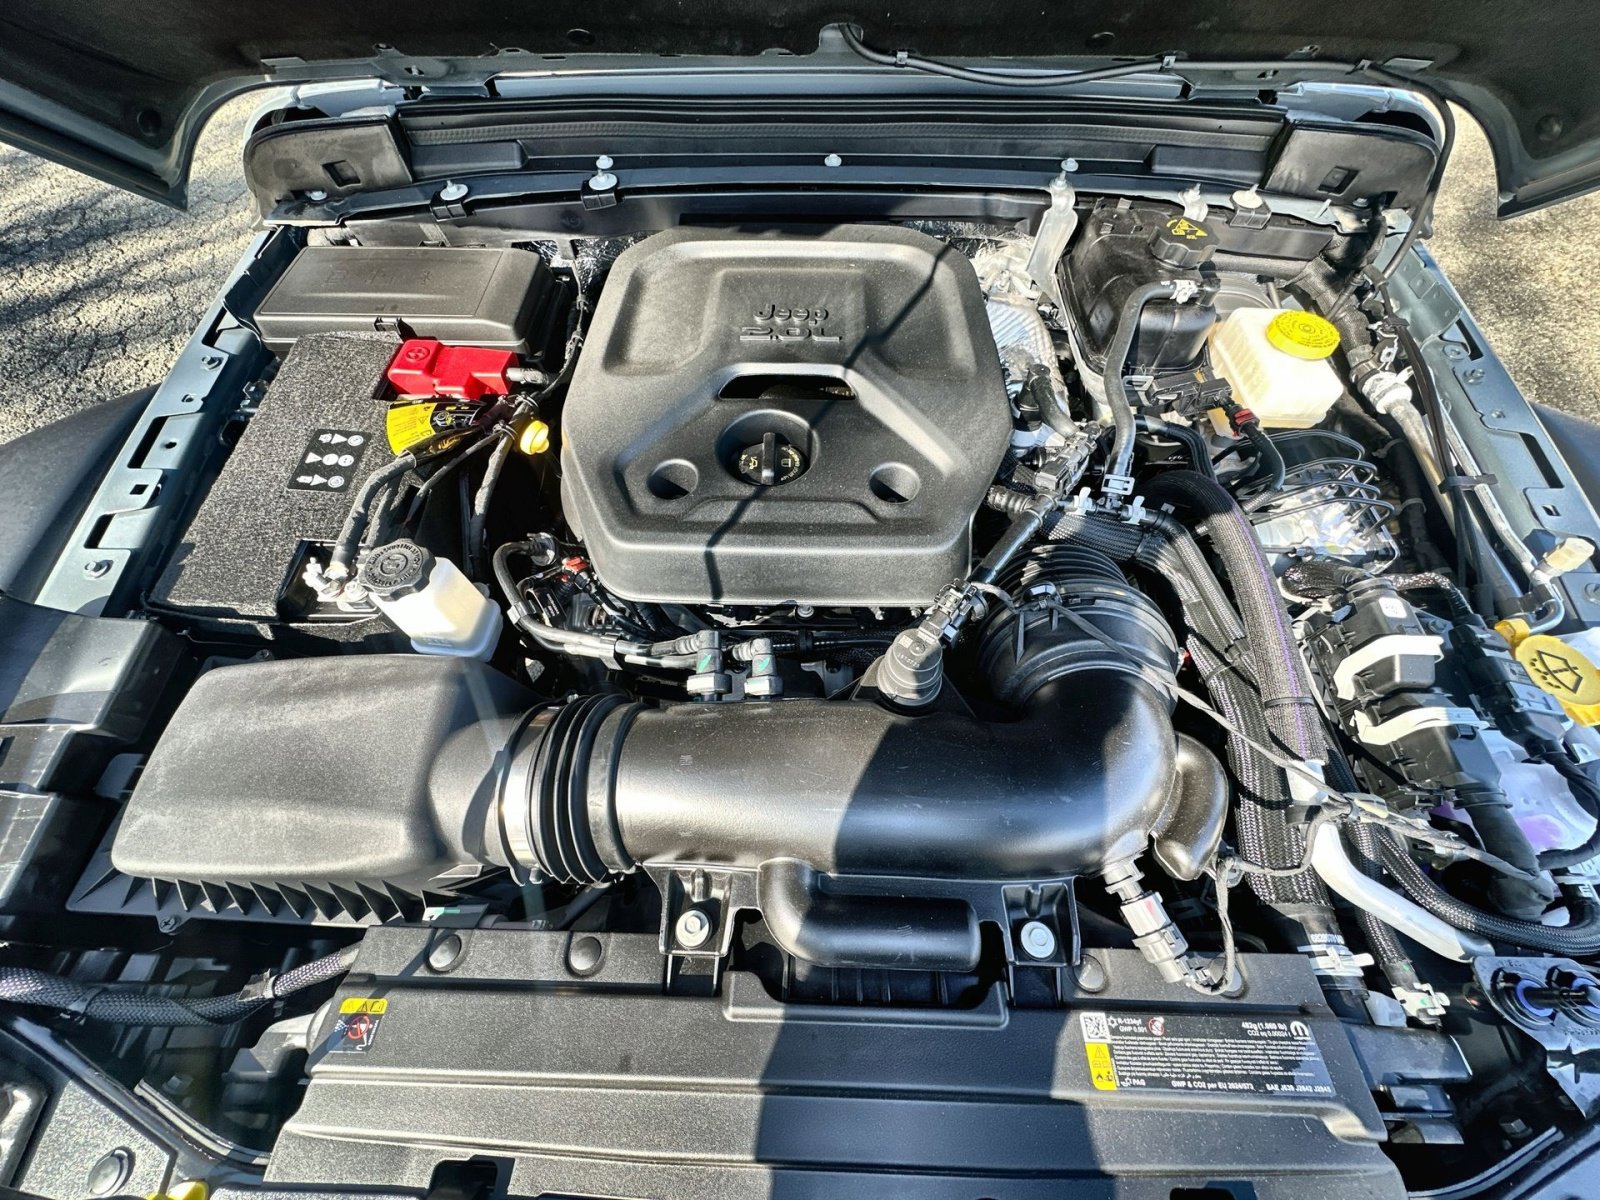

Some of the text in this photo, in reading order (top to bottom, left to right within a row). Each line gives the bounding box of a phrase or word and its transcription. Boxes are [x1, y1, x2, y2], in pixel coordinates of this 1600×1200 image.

[753, 303, 829, 326] Jeep
[739, 327, 842, 344] 2.0L
[1132, 1078, 1146, 1086] PAG
[1171, 1080, 1186, 1088] GWP
[1217, 1082, 1228, 1090] EU
[1265, 1083, 1280, 1091] SAE
